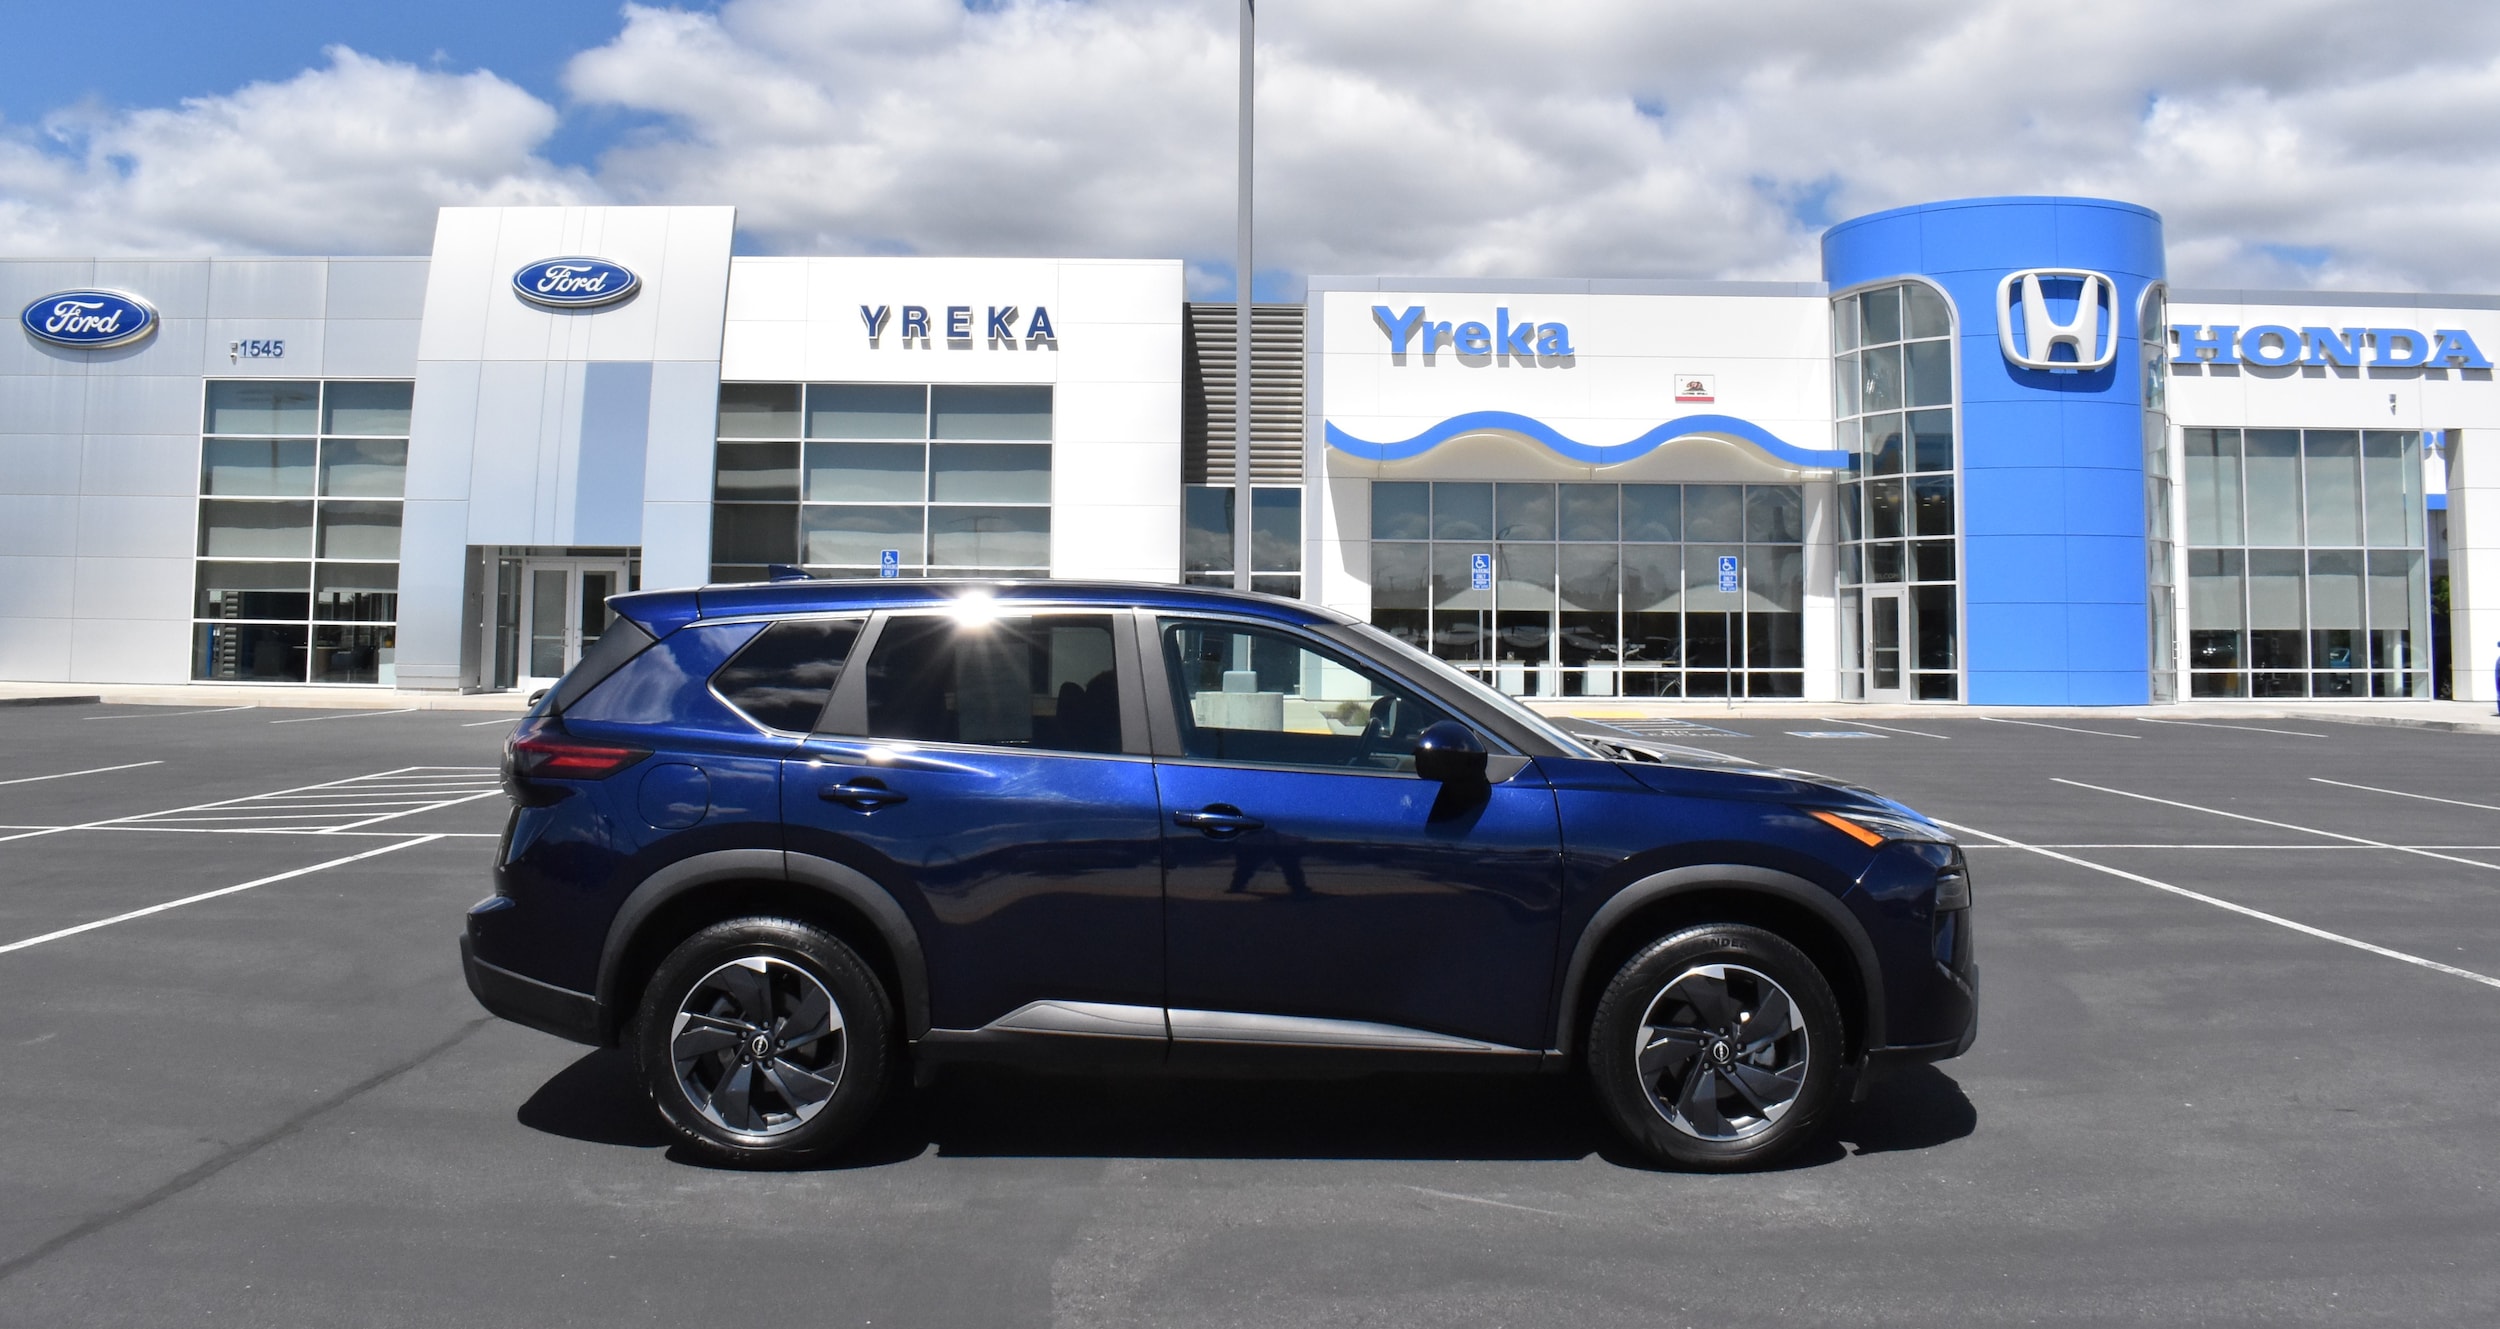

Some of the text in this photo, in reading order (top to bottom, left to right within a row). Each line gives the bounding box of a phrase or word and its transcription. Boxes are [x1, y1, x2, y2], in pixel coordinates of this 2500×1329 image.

[537, 265, 609, 293] Ford
[45, 300, 123, 333] Ford
[860, 304, 1058, 341] YREKA
[1371, 305, 1576, 356] Yreka
[240, 340, 283, 357] 1545
[2170, 324, 2494, 369] HONDA
